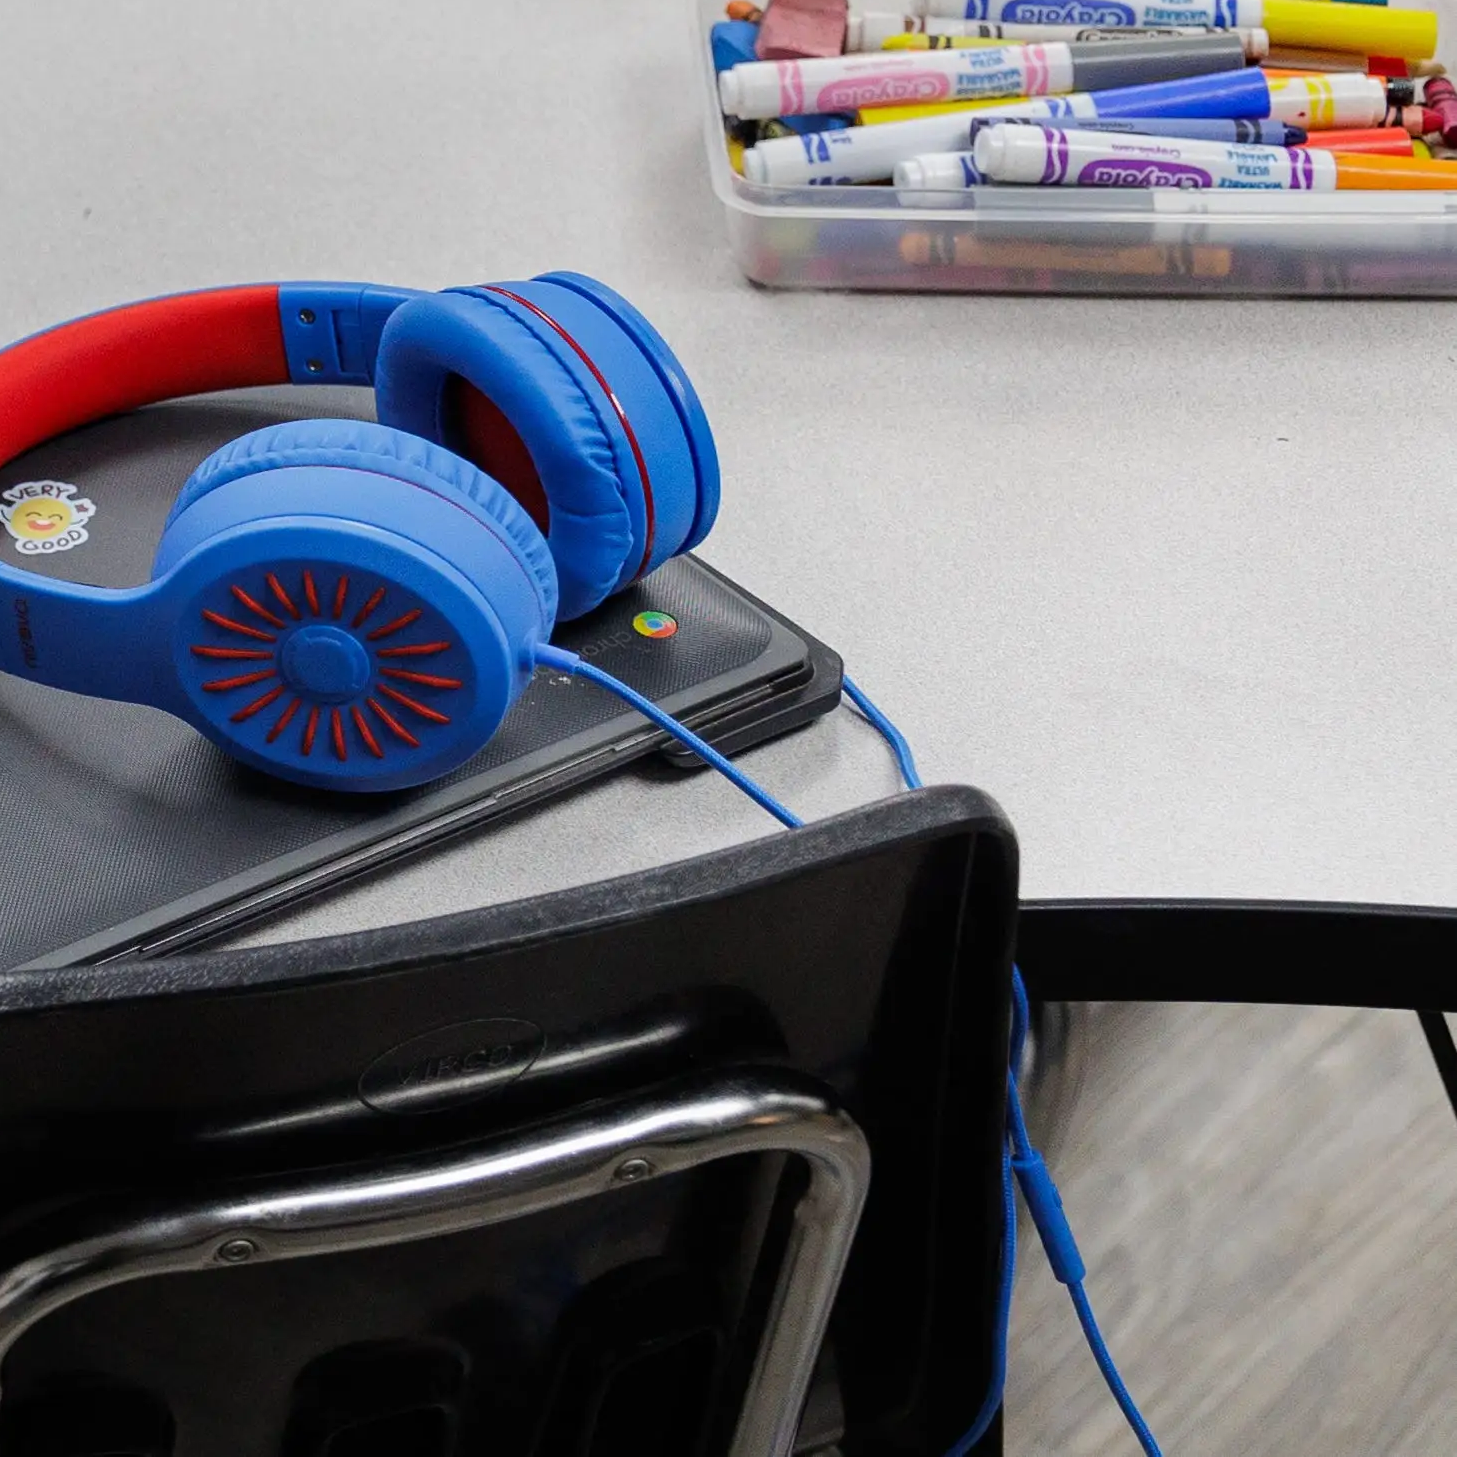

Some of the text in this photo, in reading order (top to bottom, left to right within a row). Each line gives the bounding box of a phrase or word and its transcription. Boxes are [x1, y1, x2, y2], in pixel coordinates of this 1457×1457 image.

[1016, 1, 1127, 26] Crayola
[831, 72, 942, 108] Crayola
[1095, 166, 1202, 188] Crayola
[1236, 164, 1271, 176] ULTRA
[9, 484, 70, 500] VERY
[21, 529, 83, 552] GOOD
